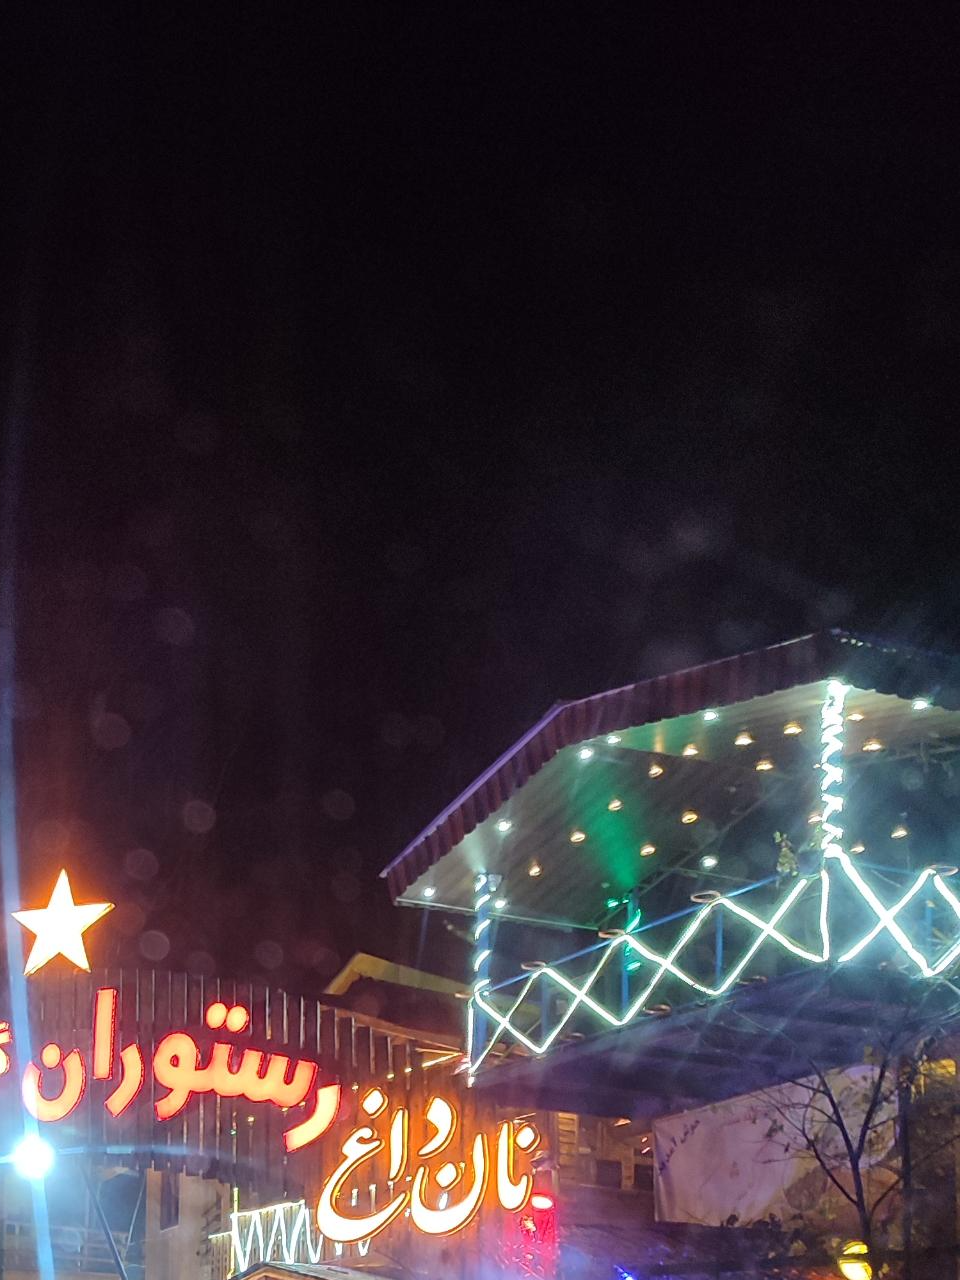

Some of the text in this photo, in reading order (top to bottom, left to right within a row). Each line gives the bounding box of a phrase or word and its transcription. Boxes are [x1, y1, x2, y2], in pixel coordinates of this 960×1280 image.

[22, 987, 341, 1152] رستوران
[317, 1087, 540, 1243] نان داغ
